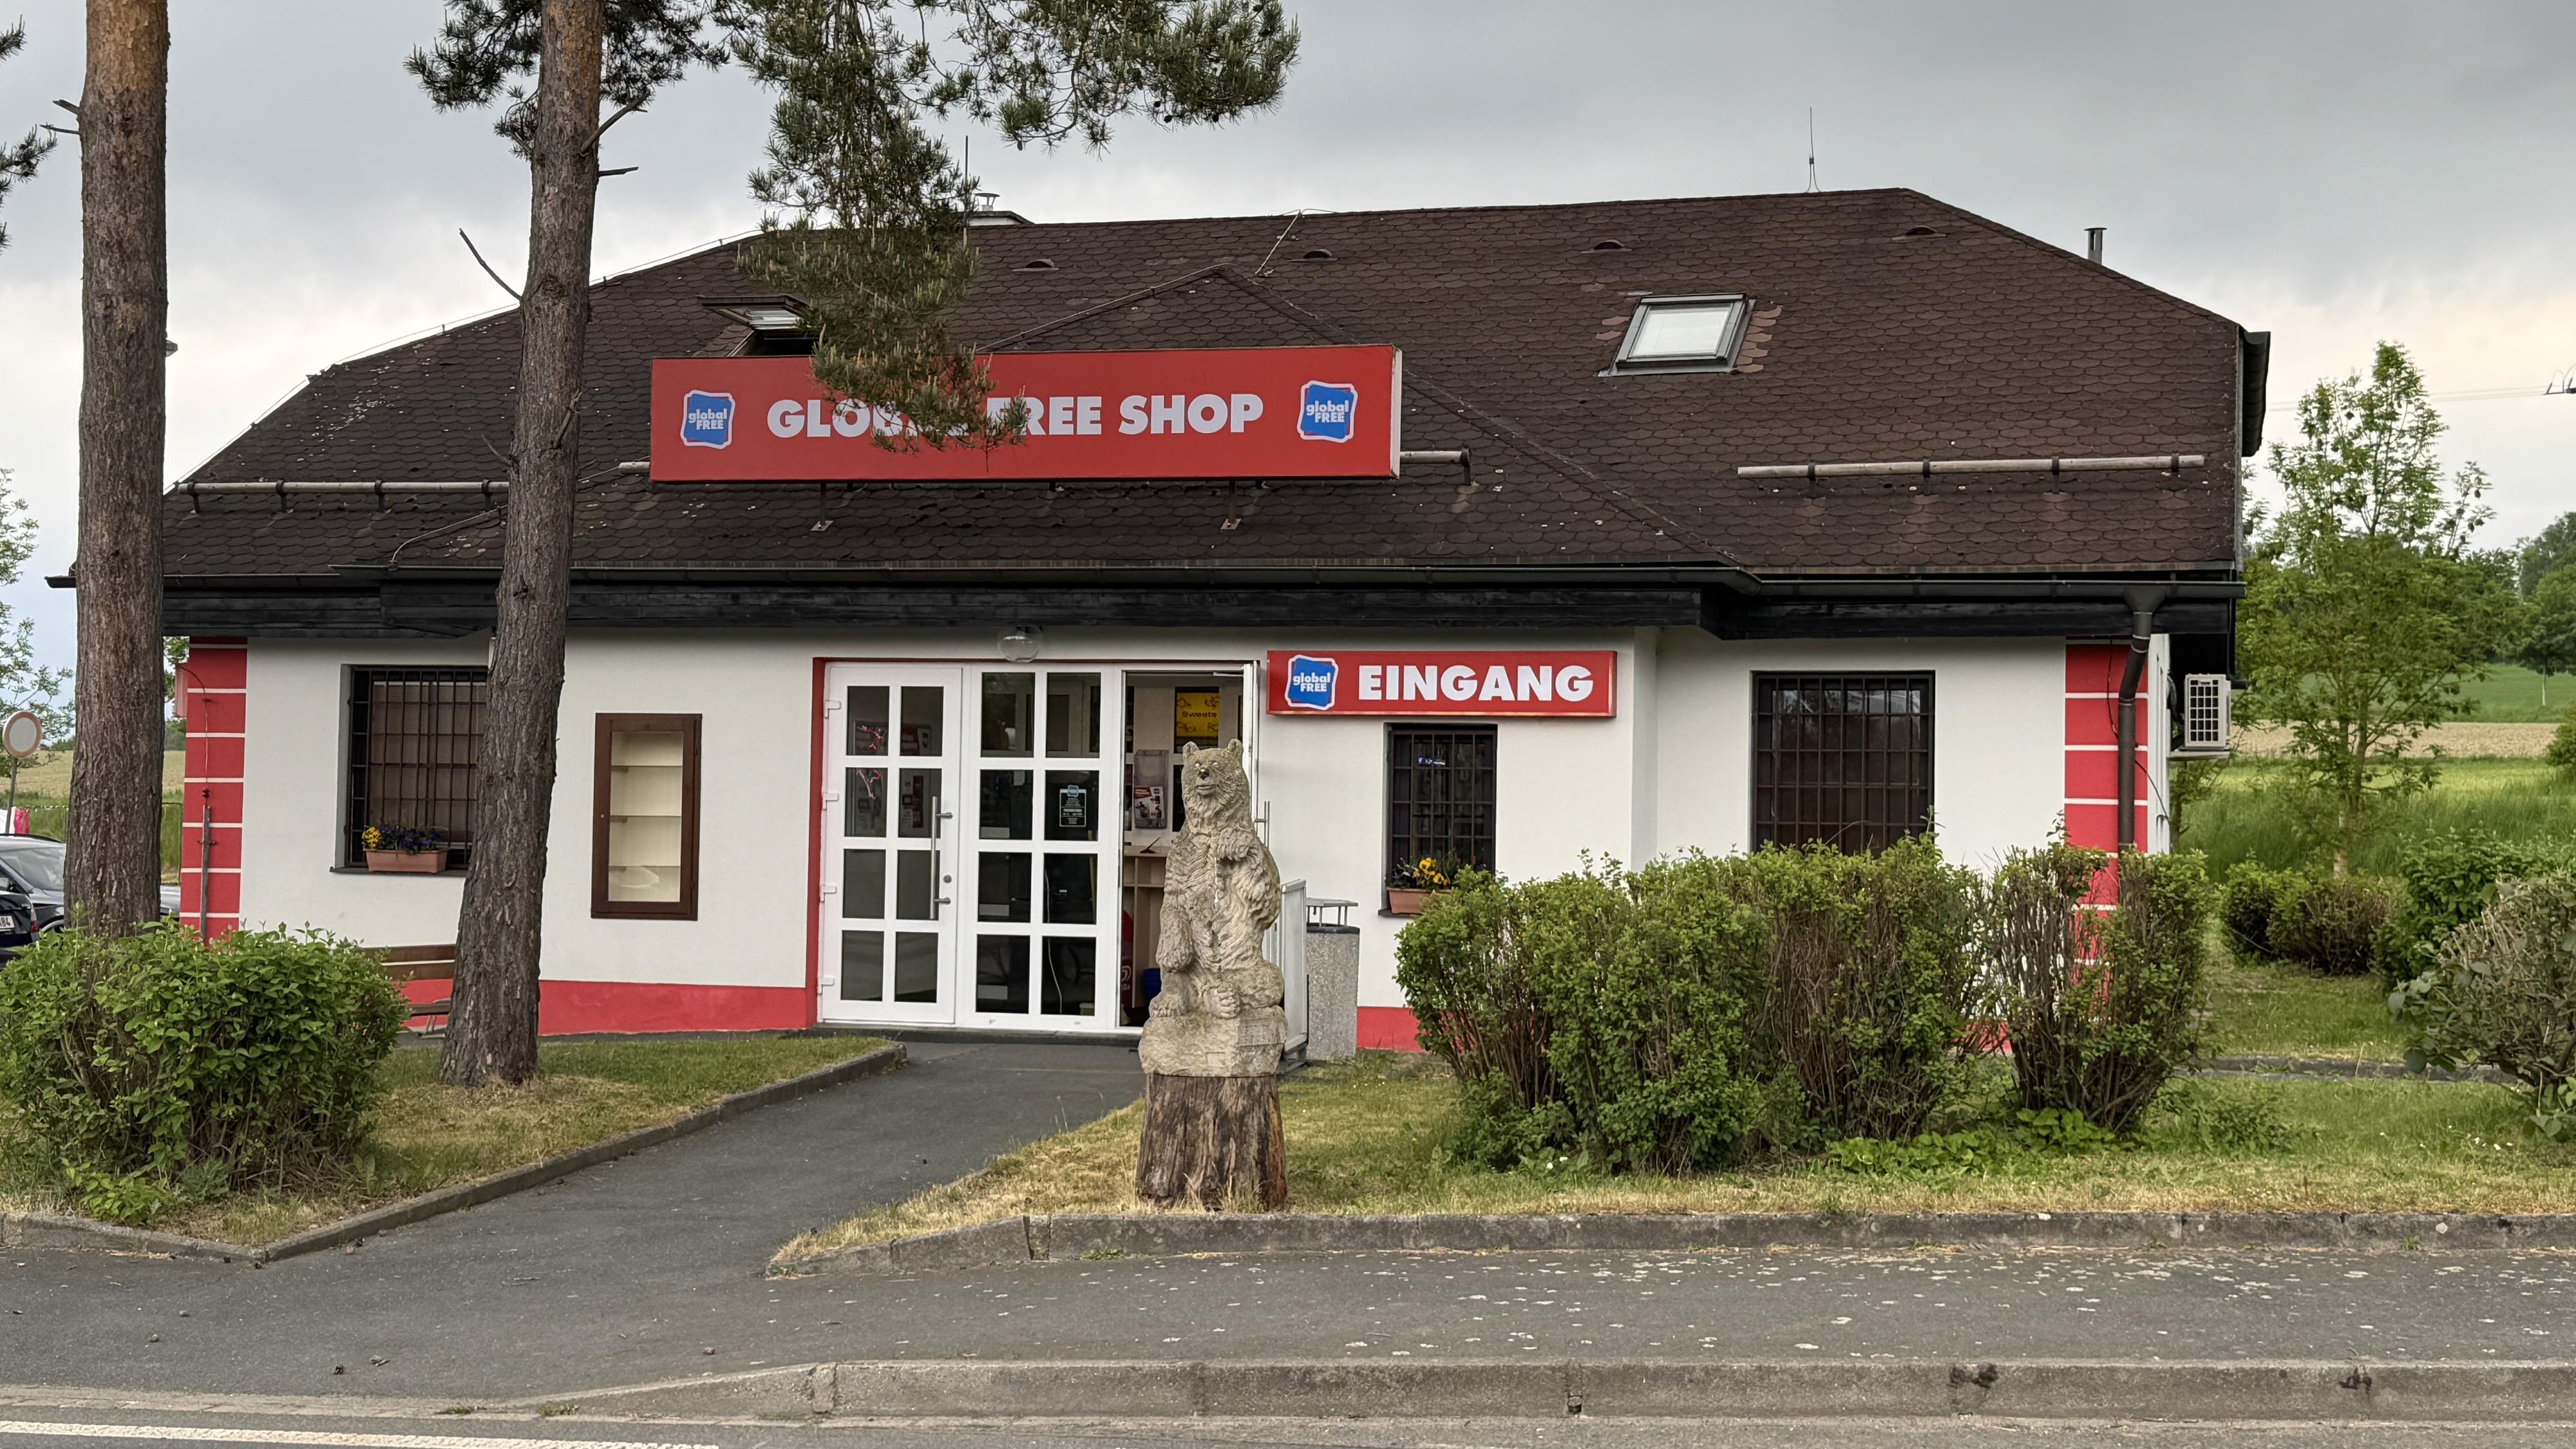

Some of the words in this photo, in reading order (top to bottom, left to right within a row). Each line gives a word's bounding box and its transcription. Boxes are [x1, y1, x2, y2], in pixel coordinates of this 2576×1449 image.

[1306, 400, 1349, 416] global
[688, 408, 728, 424] global
[766, 398, 970, 439] GLOB
[987, 396, 1103, 436] FREE
[1118, 393, 1264, 435] SHOP
[1314, 412, 1345, 423] FREE
[696, 419, 724, 430] FREE
[1293, 672, 1331, 686] global
[1358, 665, 1594, 702] EINGANG
[1300, 683, 1327, 692] FREE
